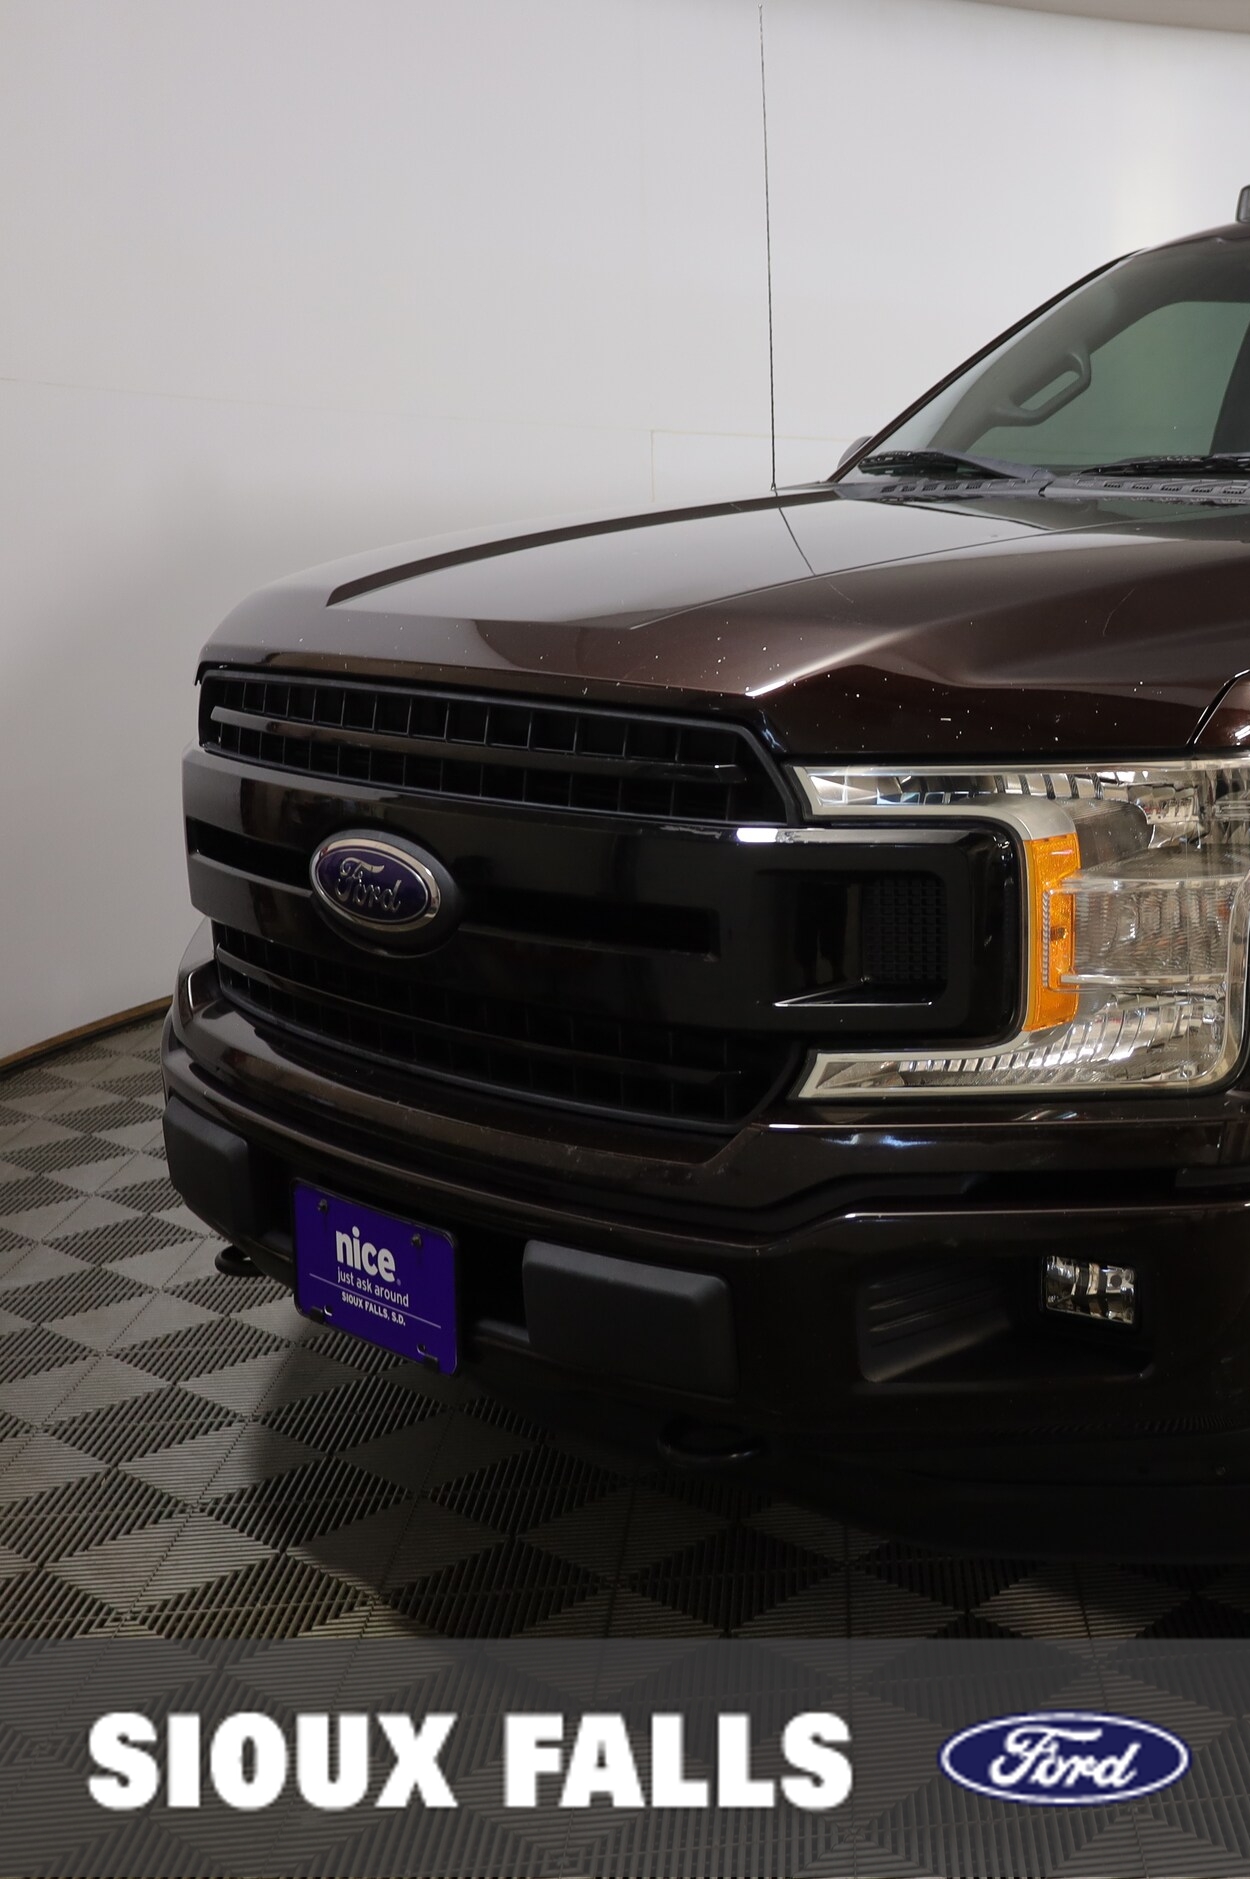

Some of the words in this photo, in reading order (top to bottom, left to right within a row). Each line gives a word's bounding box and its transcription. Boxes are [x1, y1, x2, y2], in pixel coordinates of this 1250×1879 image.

[335, 857, 402, 913] Ford
[335, 1226, 395, 1283] nice
[338, 1267, 354, 1286] just
[356, 1278, 372, 1294] ask
[375, 1284, 409, 1307] around
[342, 1292, 363, 1310] SIOUX
[391, 1311, 405, 1326] S.D.
